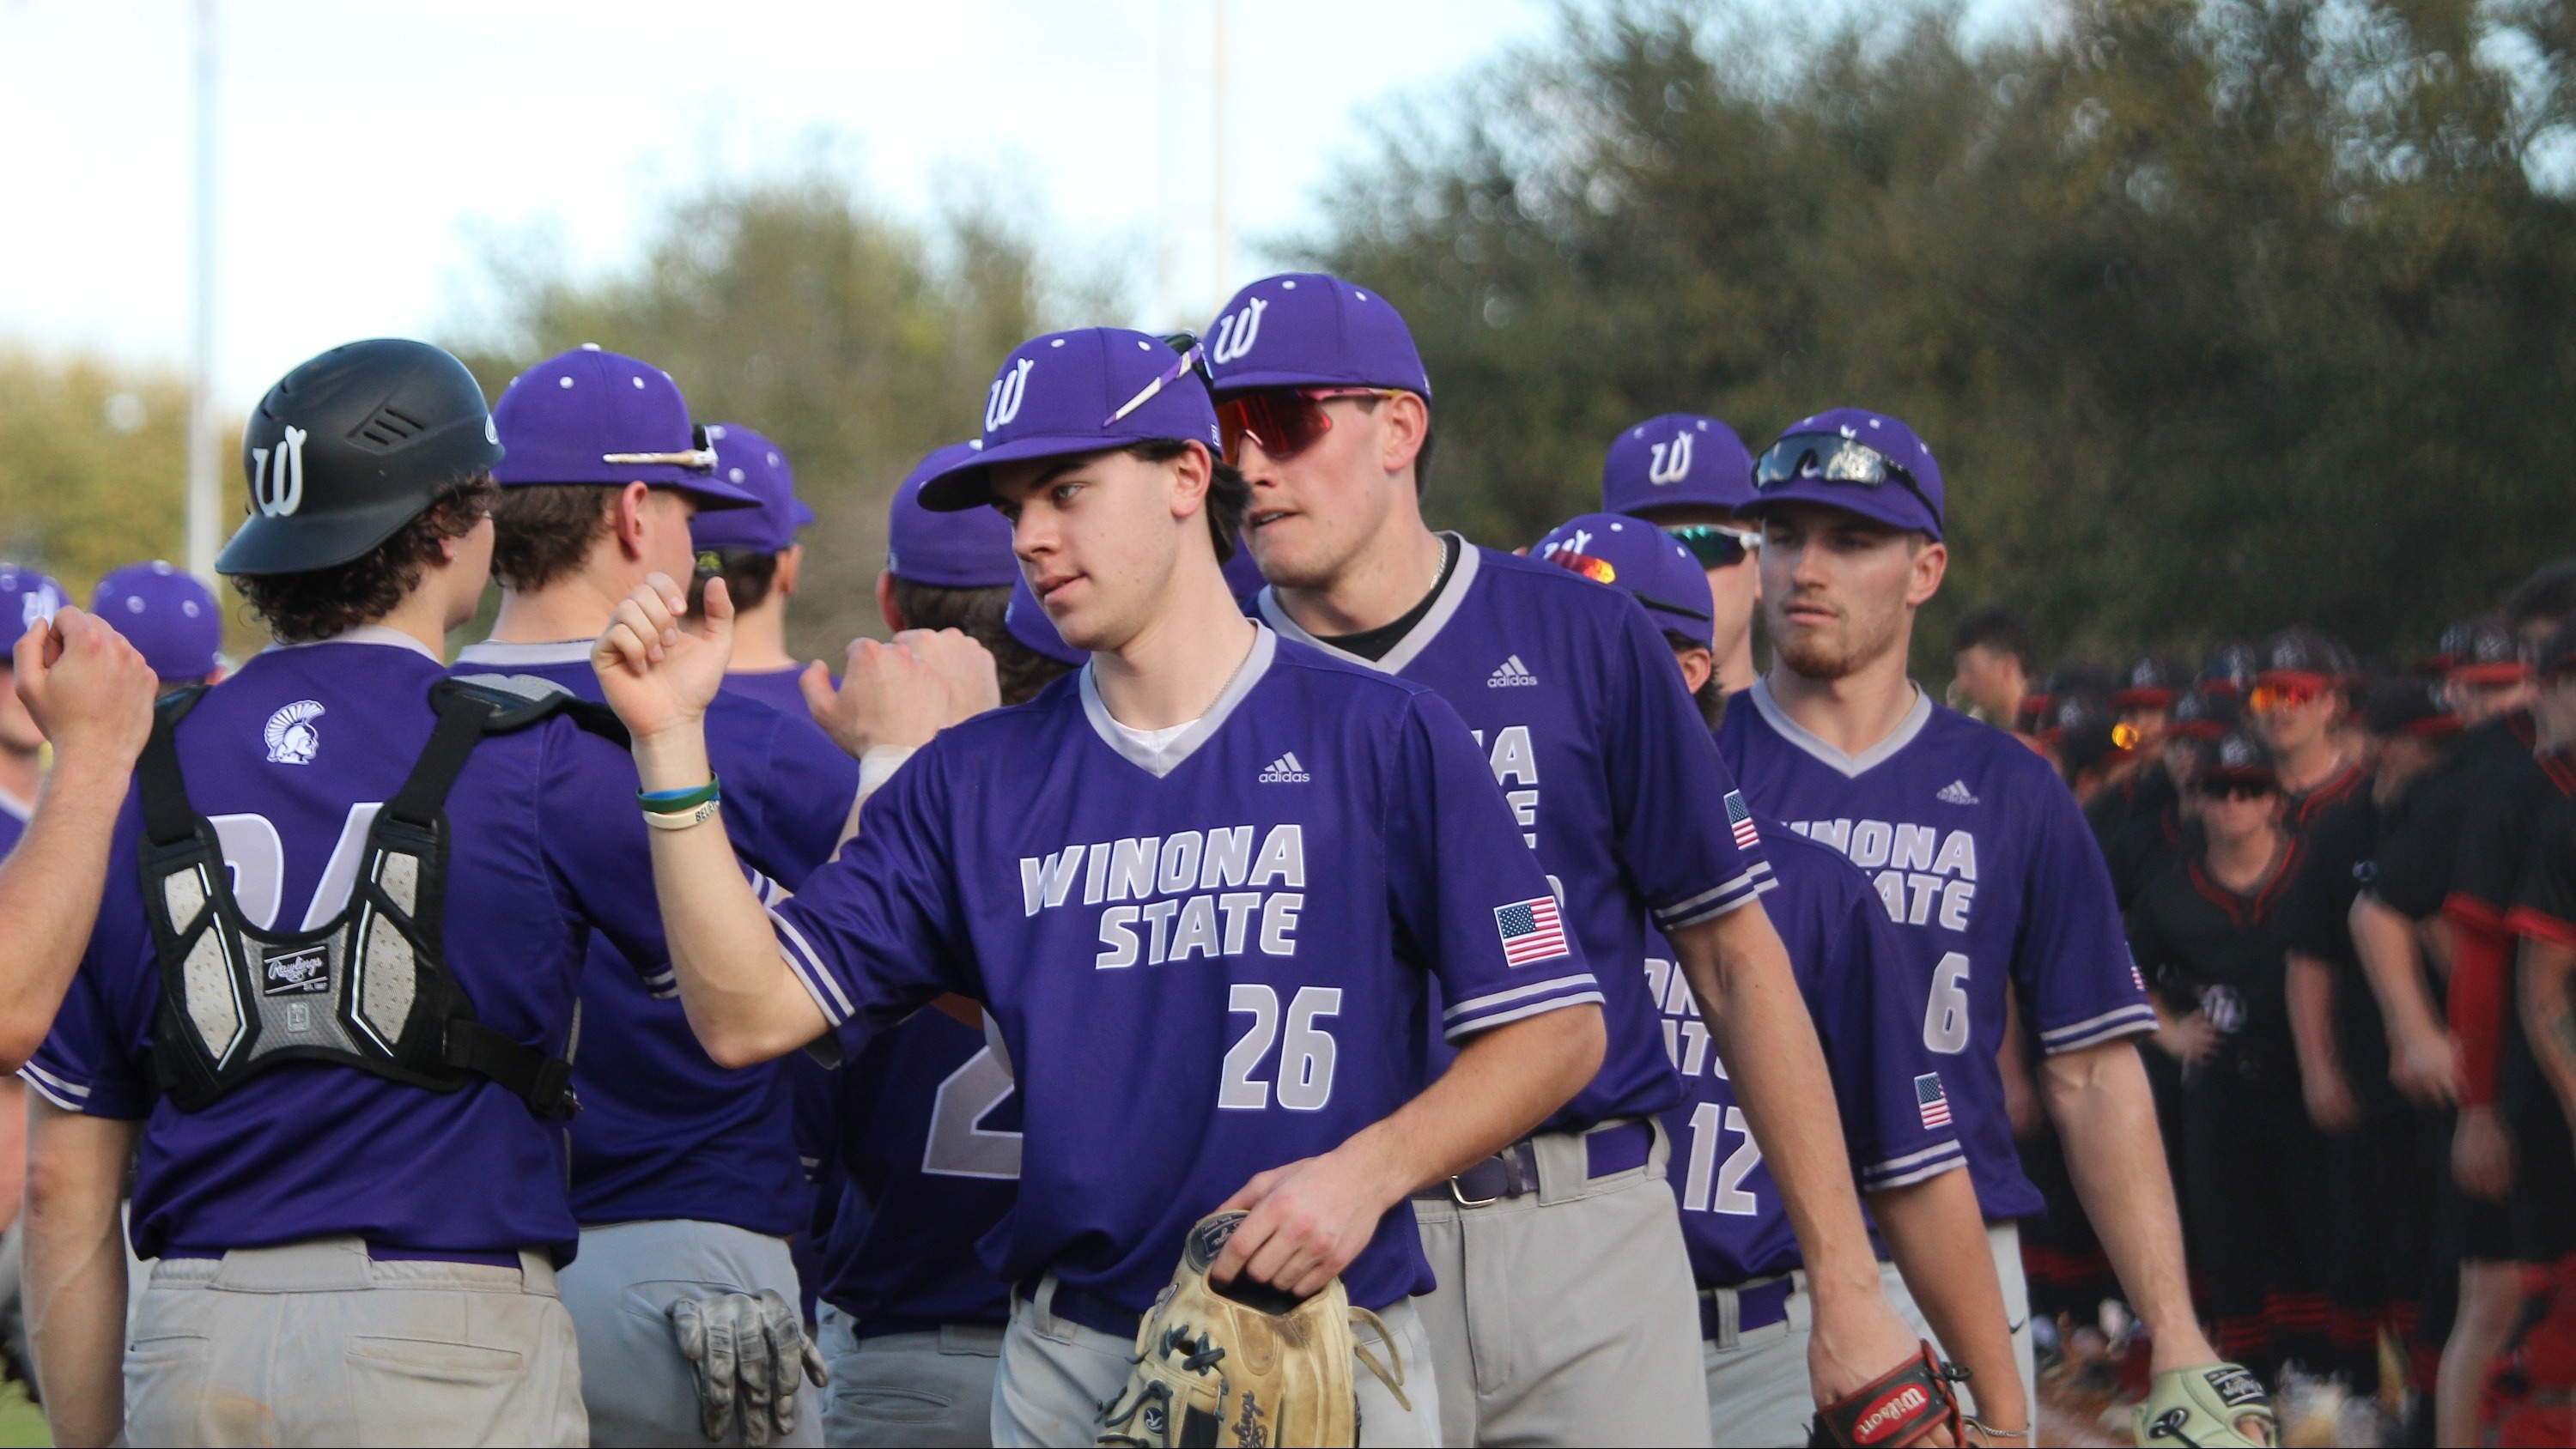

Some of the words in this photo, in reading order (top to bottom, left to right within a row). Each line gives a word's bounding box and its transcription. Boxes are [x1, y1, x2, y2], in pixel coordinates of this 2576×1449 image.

[1486, 674, 1539, 688] adidas
[1258, 771, 1310, 783] adidas
[1019, 824, 1305, 917] WINONA
[1781, 817, 1977, 881] NONA
[1095, 892, 1304, 970] STATE
[1865, 869, 1976, 933] ATE
[268, 955, 324, 980] Rawlings
[1923, 950, 1971, 1054] 6
[1218, 984, 1342, 1110] 26
[1682, 1101, 1762, 1216] 12
[1857, 1387, 1926, 1435] Wilson
